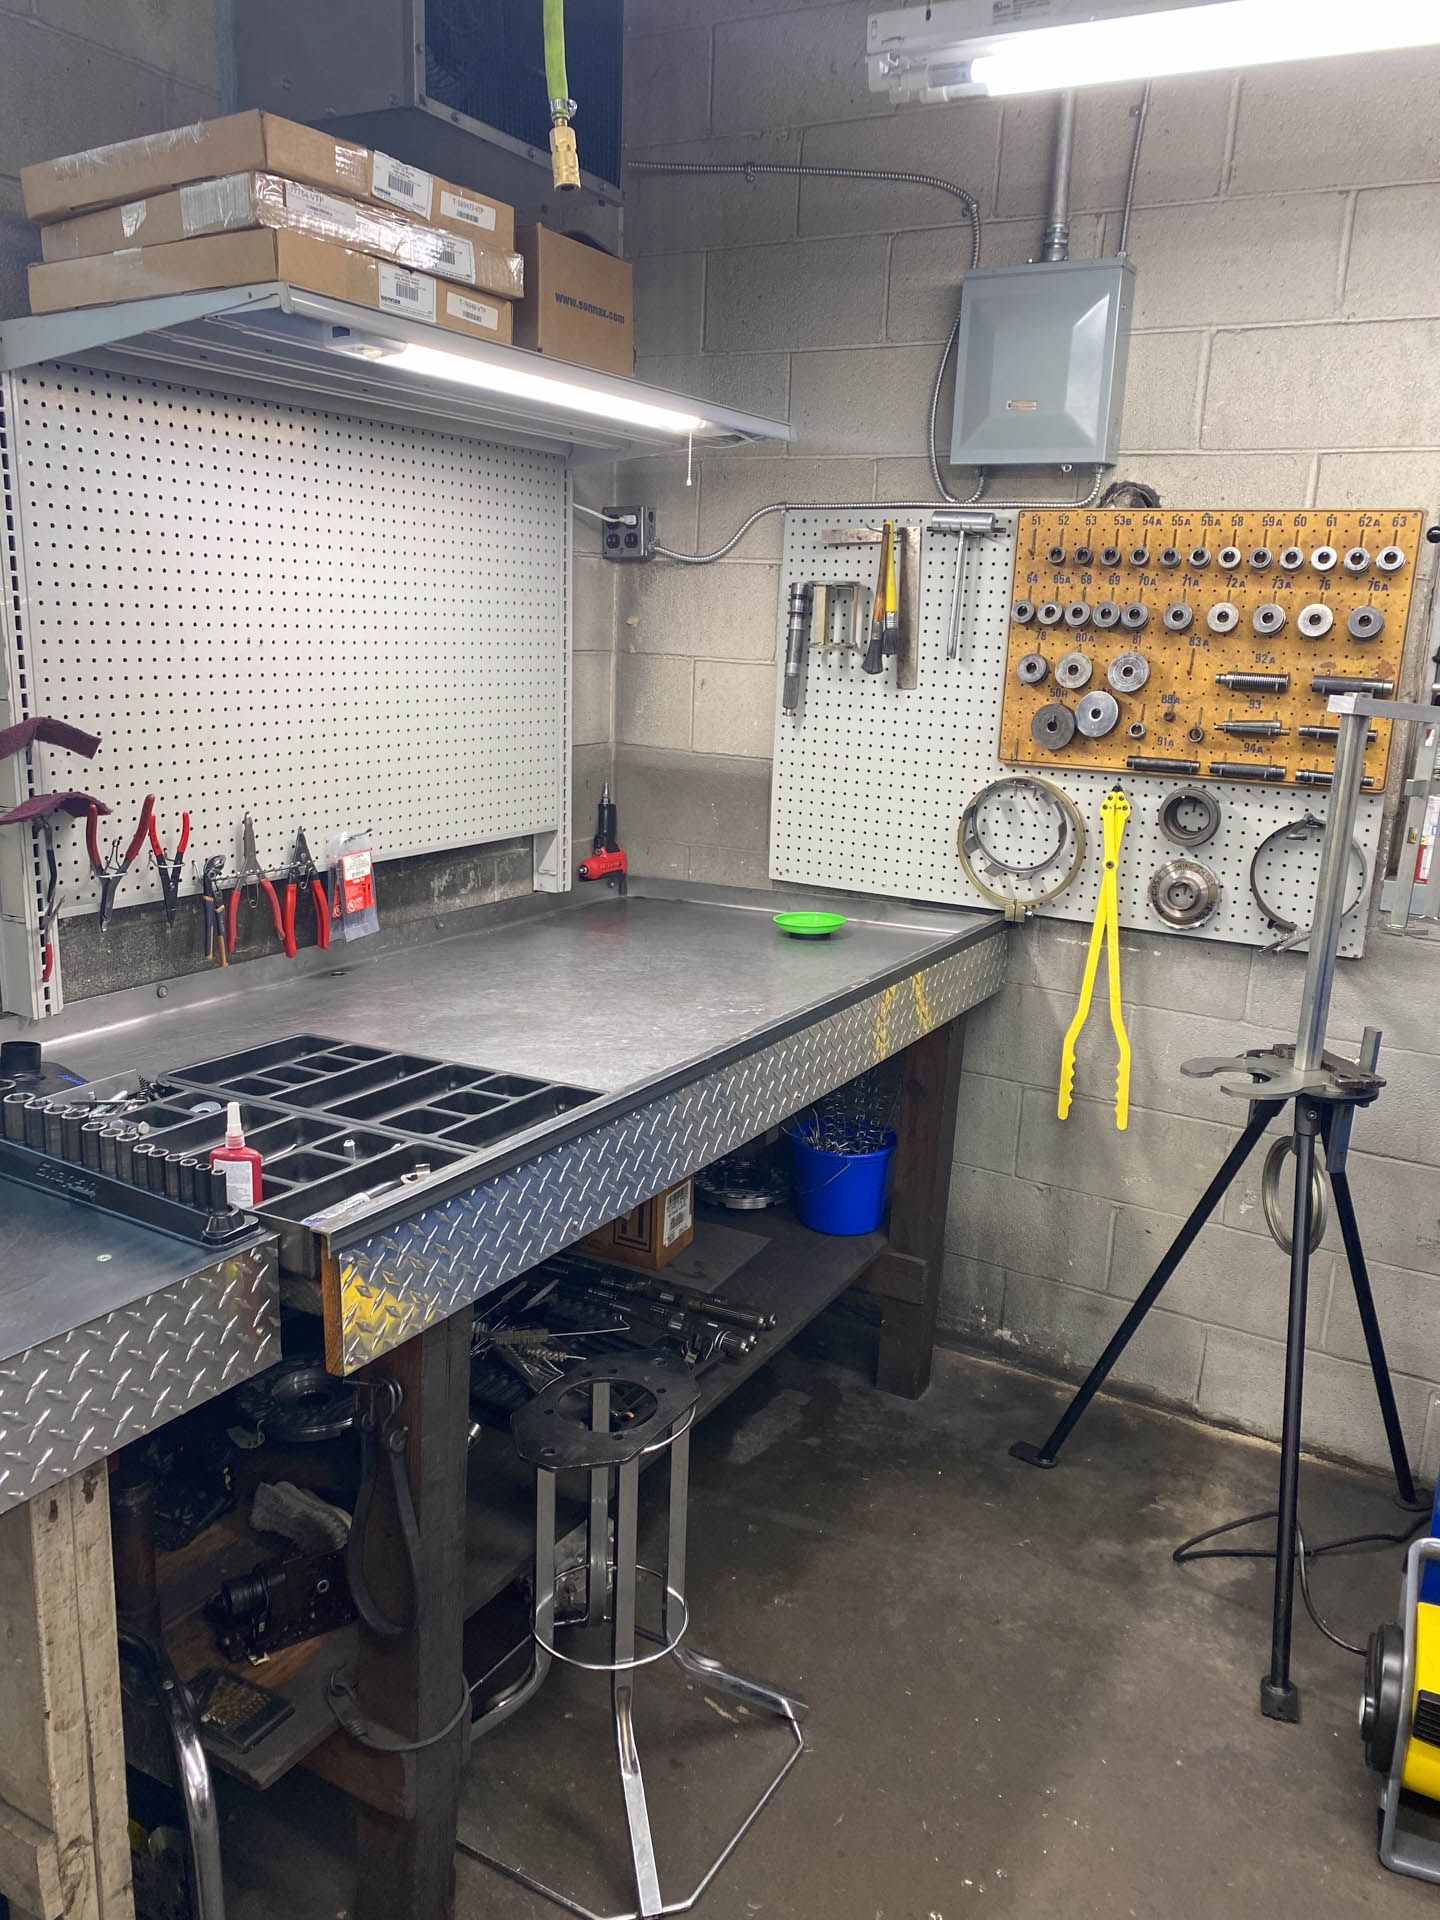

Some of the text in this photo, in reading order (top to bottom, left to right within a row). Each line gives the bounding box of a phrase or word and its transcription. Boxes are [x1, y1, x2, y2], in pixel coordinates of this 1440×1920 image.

[554, 292, 625, 324] www.sonnax.com
[1031, 515, 1041, 525] 51
[1057, 515, 1070, 525] 52
[1085, 515, 1097, 526] 53
[1142, 515, 1162, 526] 54A
[1171, 516, 1191, 526] 55A
[1200, 516, 1221, 526] 56A
[1231, 516, 1244, 527] 58
[1262, 516, 1282, 527] 59A
[1293, 516, 1306, 527] 60
[1326, 516, 1337, 527] 61
[1358, 516, 1380, 527] 62A
[1391, 517, 1407, 527] 63
[1026, 573, 1038, 584] 64
[1053, 574, 1071, 584] 65A
[1080, 574, 1092, 585] 68
[1108, 575, 1121, 585] 69
[1138, 575, 1157, 586] 70A
[1182, 576, 1199, 587] 71A
[1225, 577, 1246, 588] 72A
[1271, 578, 1292, 589] 73A
[1367, 580, 1389, 592] 76A
[1036, 630, 1209, 647] 78 80A 81 83A
[1254, 653, 1276, 665] 92A
[1248, 699, 1262, 709] 93
[1157, 736, 1175, 748] 91A
[1243, 743, 1264, 754] 94A
